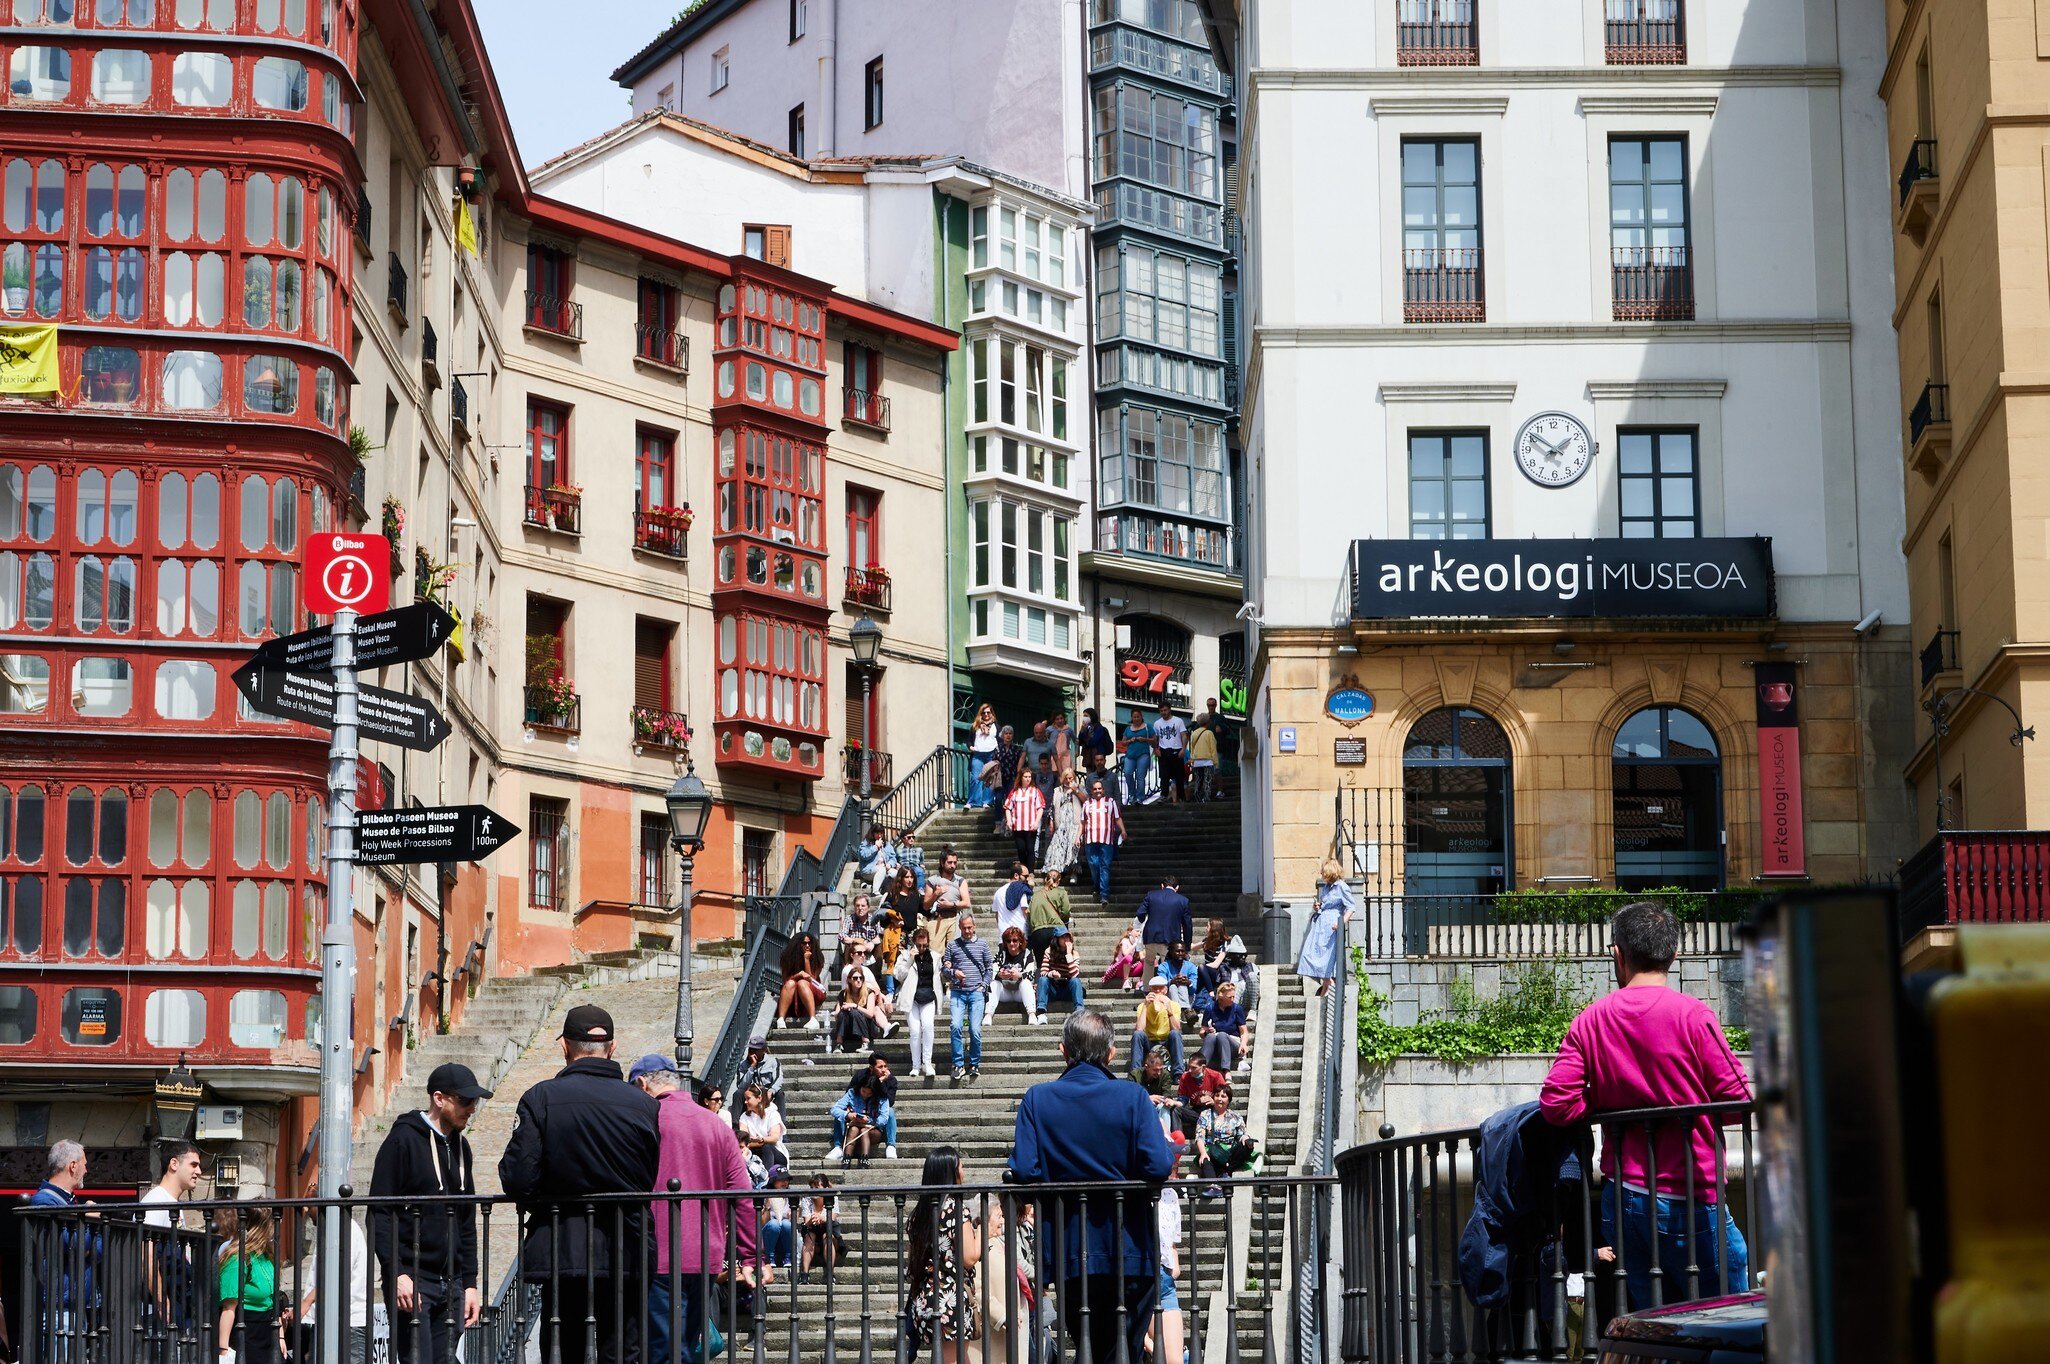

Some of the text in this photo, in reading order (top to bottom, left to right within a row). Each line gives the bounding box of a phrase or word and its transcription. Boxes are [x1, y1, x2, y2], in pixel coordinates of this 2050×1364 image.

[1535, 425, 1543, 433] 11
[1549, 421, 1558, 429] 12
[1573, 432, 1579, 441] 2
[1525, 445, 1532, 454] 9
[1577, 445, 1584, 454] 3
[1529, 459, 1536, 468] 8
[1573, 458, 1580, 466] 4
[1539, 466, 1545, 475] 7
[1551, 470, 1558, 479] 6
[1565, 466, 1572, 475] 5
[1379, 549, 1747, 600] arkeologi MUSEOA
[358, 620, 397, 635] Euskal Museoa
[287, 634, 333, 653] Museoen Ibilbidea
[357, 634, 391, 648] Museo Vasco
[305, 651, 313, 661] los
[313, 647, 333, 659] Museos
[357, 645, 399, 661] Basque Museum
[286, 671, 333, 693] Museoen Ibilbidea
[1121, 659, 1192, 697] 97 FM
[283, 684, 333, 706] Ruta de los Museos
[276, 695, 292, 708] Route
[298, 701, 307, 712] the
[307, 703, 332, 719] Museums
[358, 691, 425, 716] Bizkaiko Arkeologi Museoa
[358, 704, 375, 717] Museo
[375, 708, 383, 719] de
[358, 716, 416, 738] Archaeological Museum
[1773, 733, 1790, 864] arkeologi MUSEOA
[362, 811, 459, 825] Bilboko Pasoen Museoa
[362, 824, 455, 837] Museo de Pasos Bilbao
[361, 837, 452, 852] Holy Week Processions
[476, 836, 498, 846] 100m
[1448, 837, 1492, 848] arkeologi
[361, 852, 396, 862] Museum
